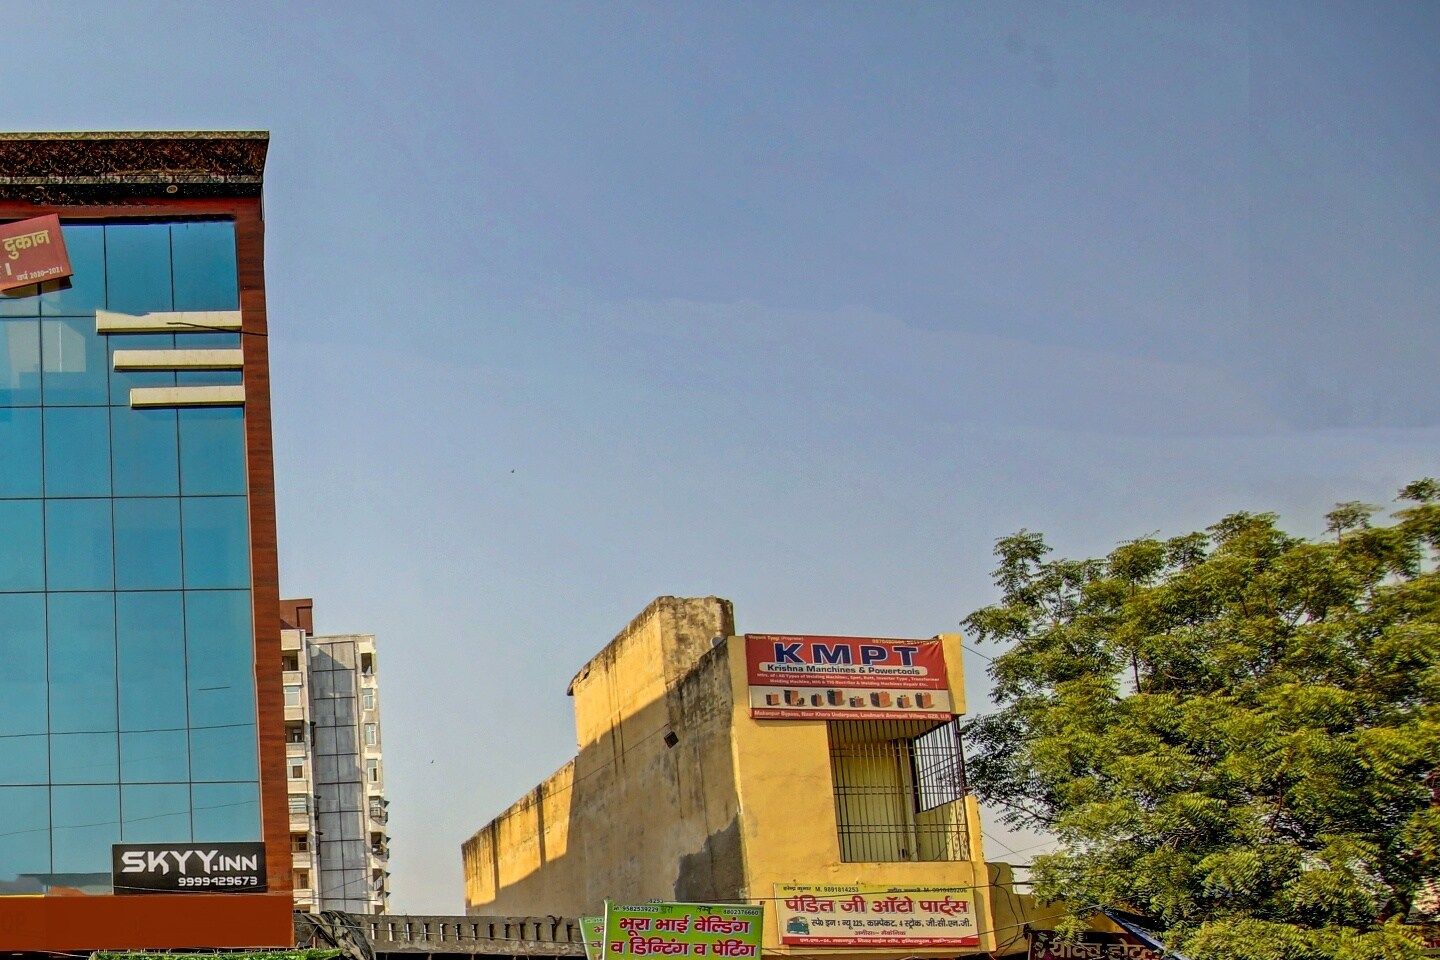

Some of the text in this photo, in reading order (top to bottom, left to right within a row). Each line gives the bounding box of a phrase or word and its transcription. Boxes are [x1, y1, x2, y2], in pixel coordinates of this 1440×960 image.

[2, 229, 51, 260] दुकान
[767, 663, 804, 673] Krishna
[806, 665, 856, 674] Manchines
[869, 667, 920, 675] Powertools
[121, 850, 258, 876] SKYY.INN
[177, 876, 258, 886] 9999429673
[784, 894, 968, 916] पंडित जी ऑटो पार्ट्स
[619, 914, 750, 939] भूरा भाई वेल्डिंग
[611, 941, 624, 953] व
[694, 943, 708, 955] व
